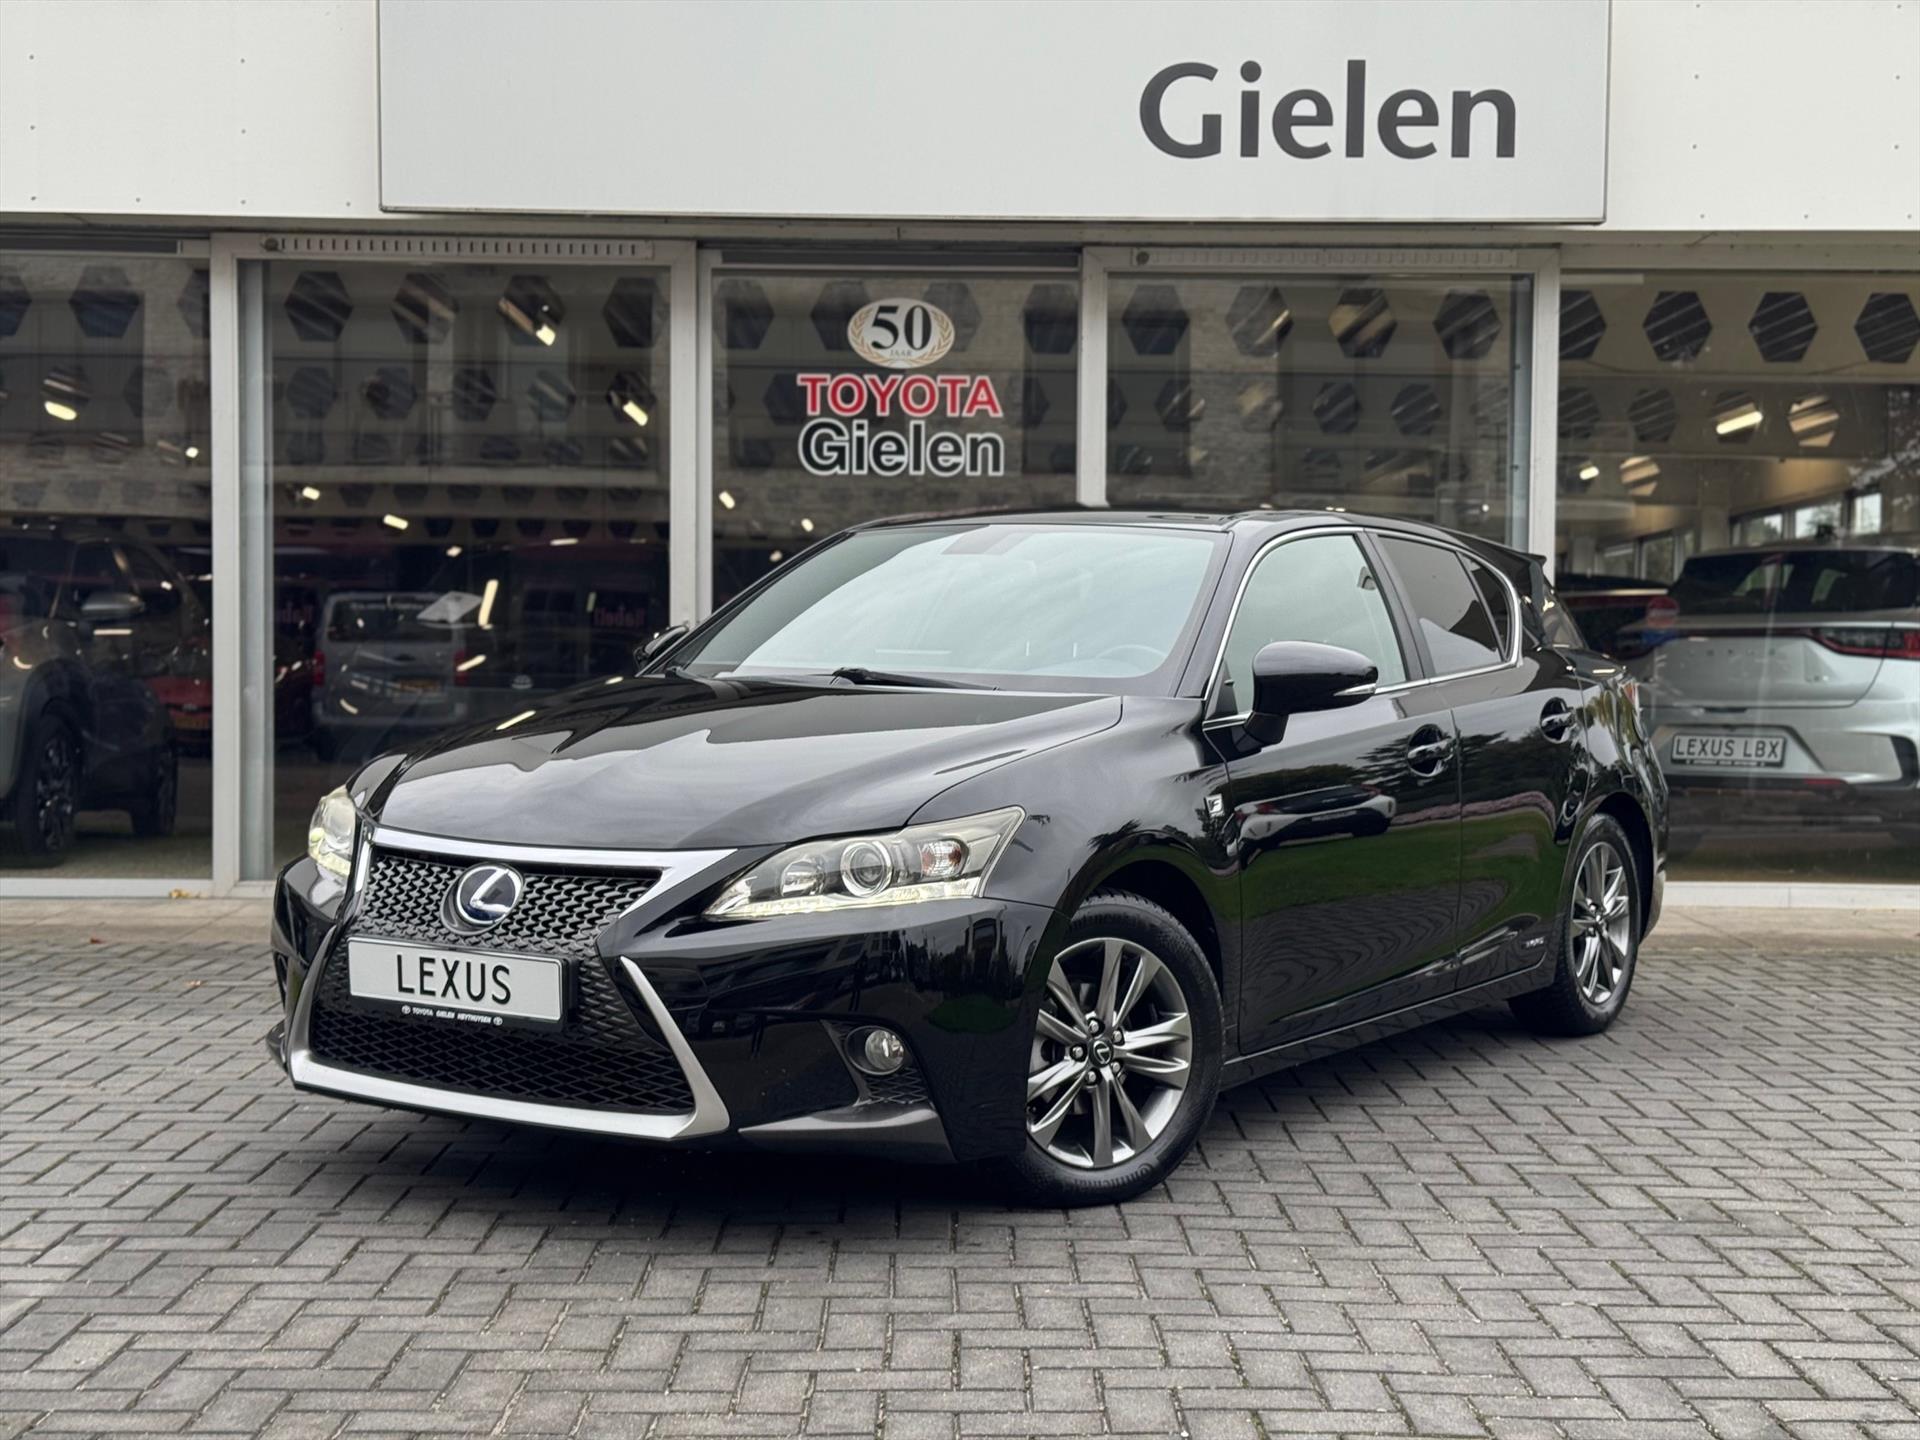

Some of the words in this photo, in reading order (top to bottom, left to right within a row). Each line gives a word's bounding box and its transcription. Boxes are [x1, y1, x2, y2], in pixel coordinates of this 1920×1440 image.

[1139, 59, 1516, 159] Gielen
[871, 304, 932, 350] 50
[797, 373, 1003, 417] TOYOTA
[798, 418, 1004, 476] Gielen
[1675, 738, 1735, 757] LEXUS
[1743, 740, 1779, 759] LBX
[397, 954, 511, 1005] LEXUS
[412, 1006, 434, 1016] TOYOTA
